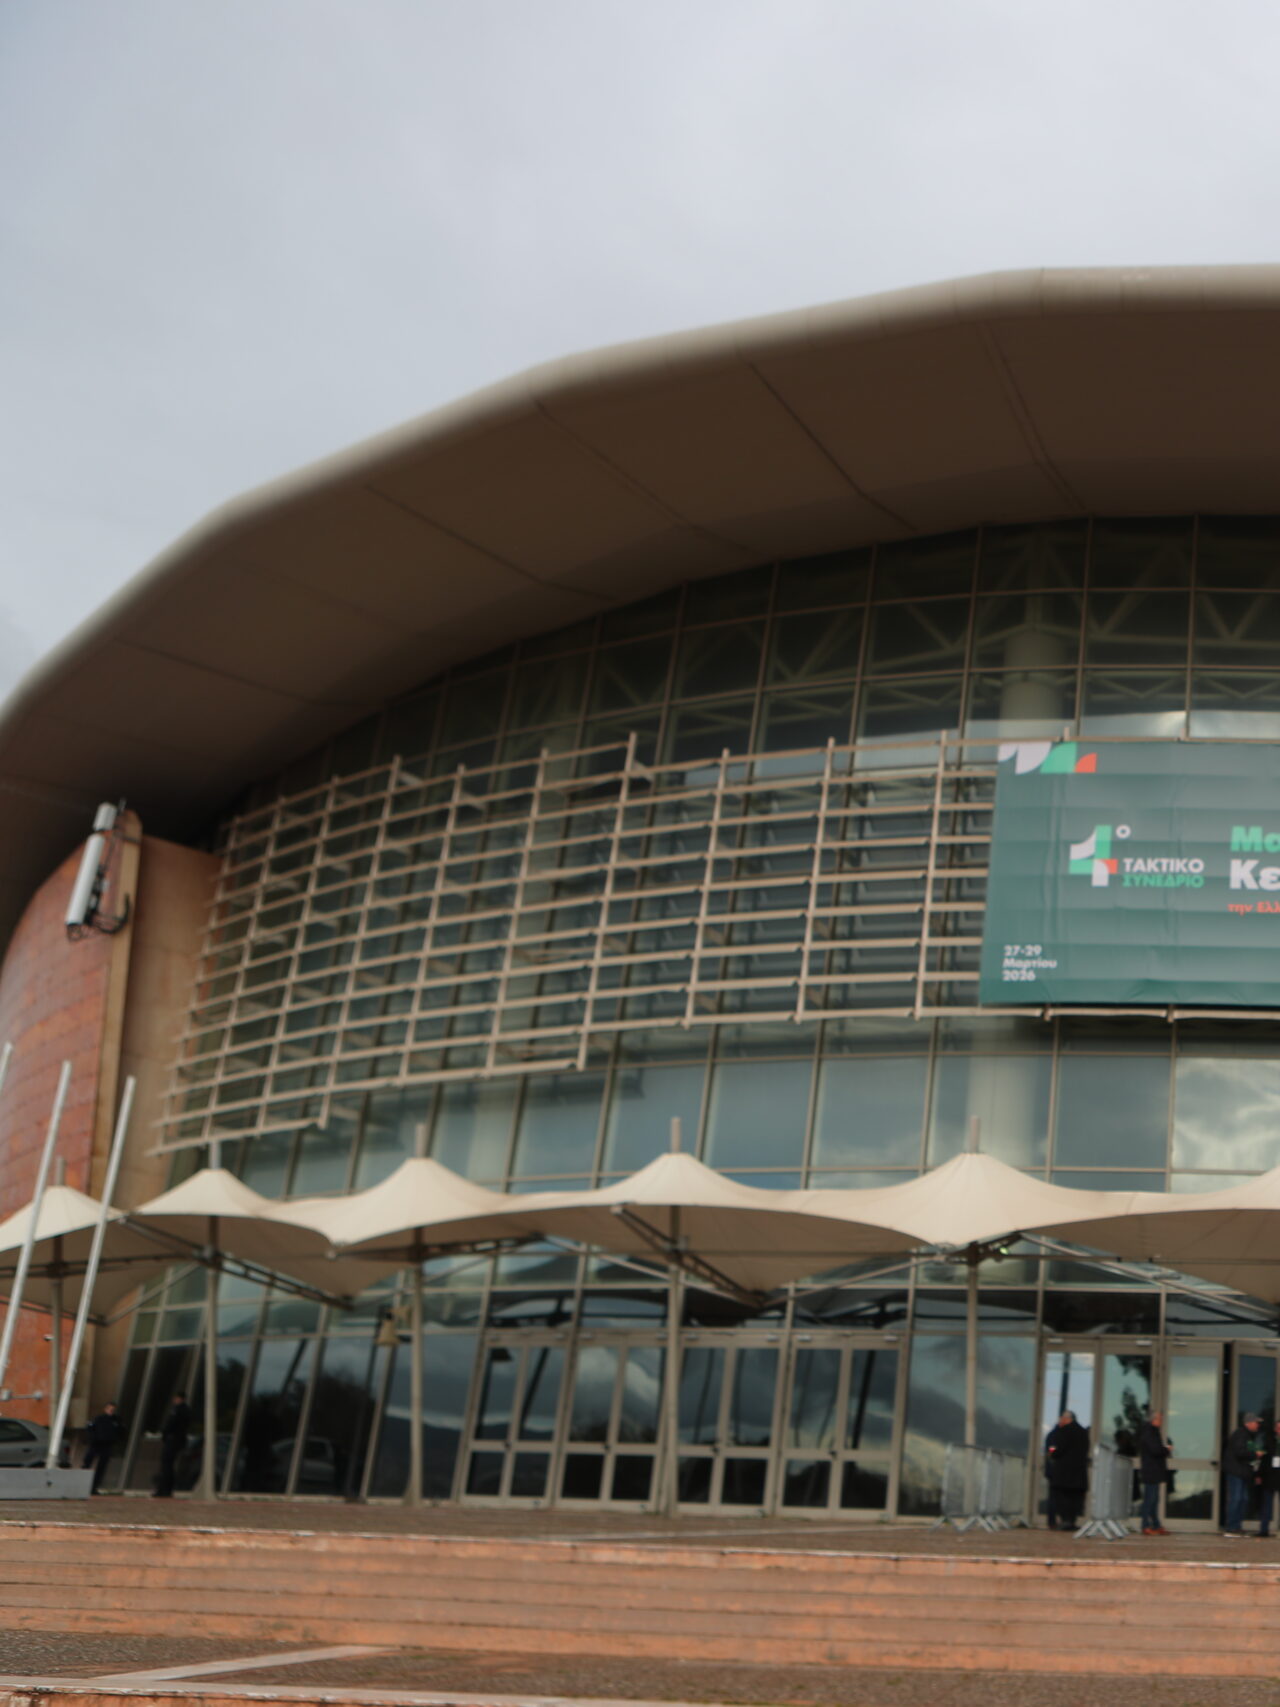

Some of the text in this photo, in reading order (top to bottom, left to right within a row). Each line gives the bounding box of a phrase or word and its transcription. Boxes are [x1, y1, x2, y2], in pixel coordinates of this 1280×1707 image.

[1123, 858, 1205, 873] ΤΑΚΤΙΚΟ
[1122, 874, 1205, 888] ΣΥΝΕΔΡΙΟ
[1228, 902, 1253, 916] την
